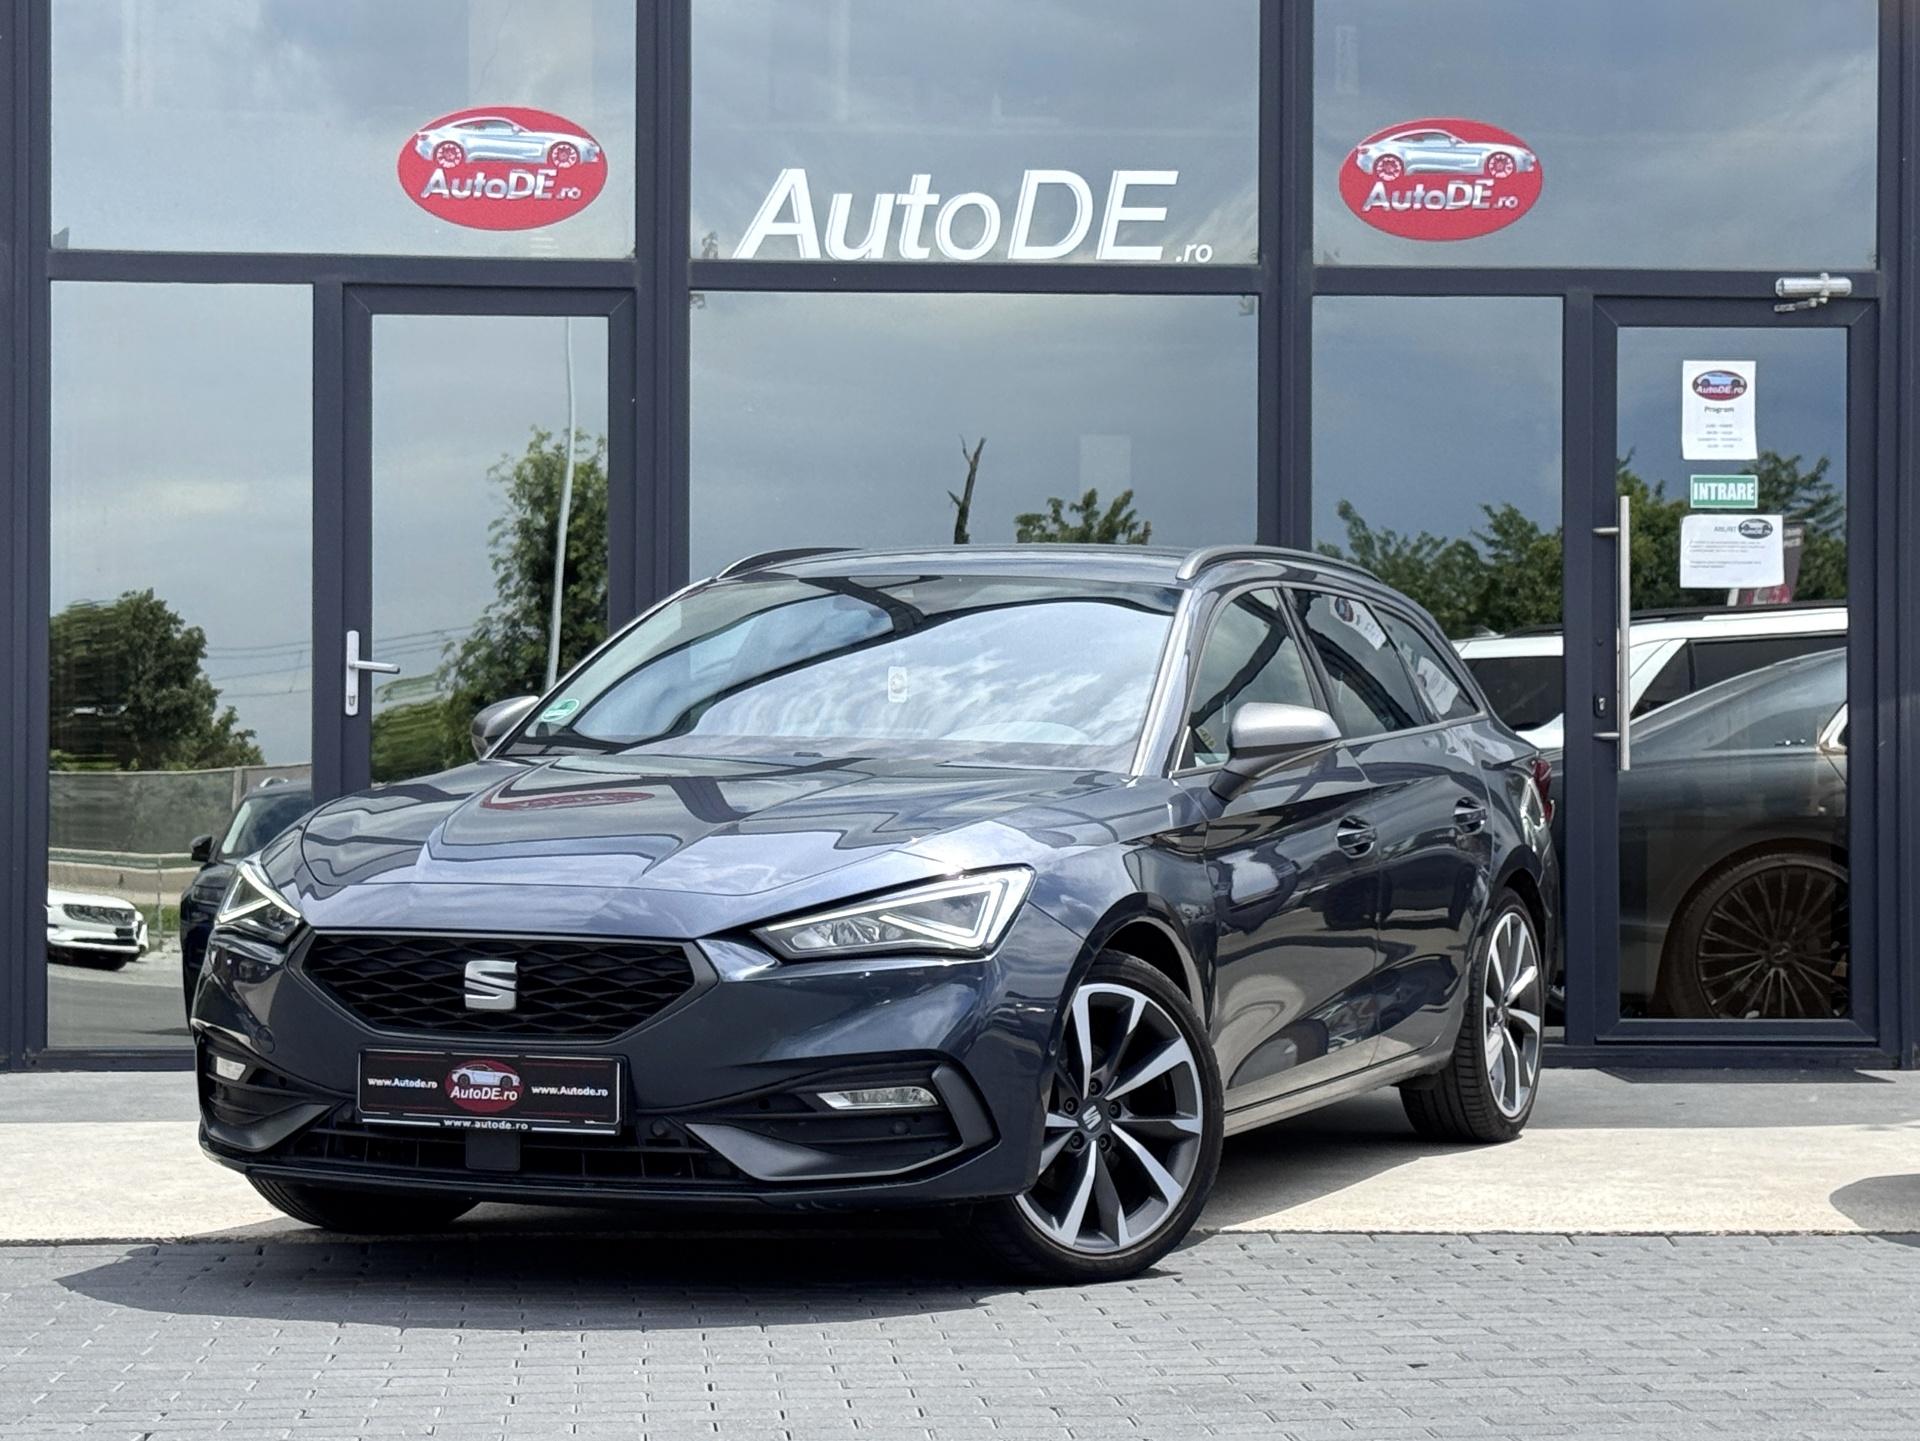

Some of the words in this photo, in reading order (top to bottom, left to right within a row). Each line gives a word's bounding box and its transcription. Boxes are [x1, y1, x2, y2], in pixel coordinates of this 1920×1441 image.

[420, 168, 582, 200] AutoDE.ro
[1362, 178, 1519, 212] AutoDE.ro
[1693, 481, 1755, 501] INTRARE
[367, 1077, 438, 1089] www.Autode.ro
[531, 1084, 609, 1097] www.Autode.ro
[450, 1085, 518, 1102] AutoDE.ro
[443, 1118, 529, 1131] www.autode.ro
